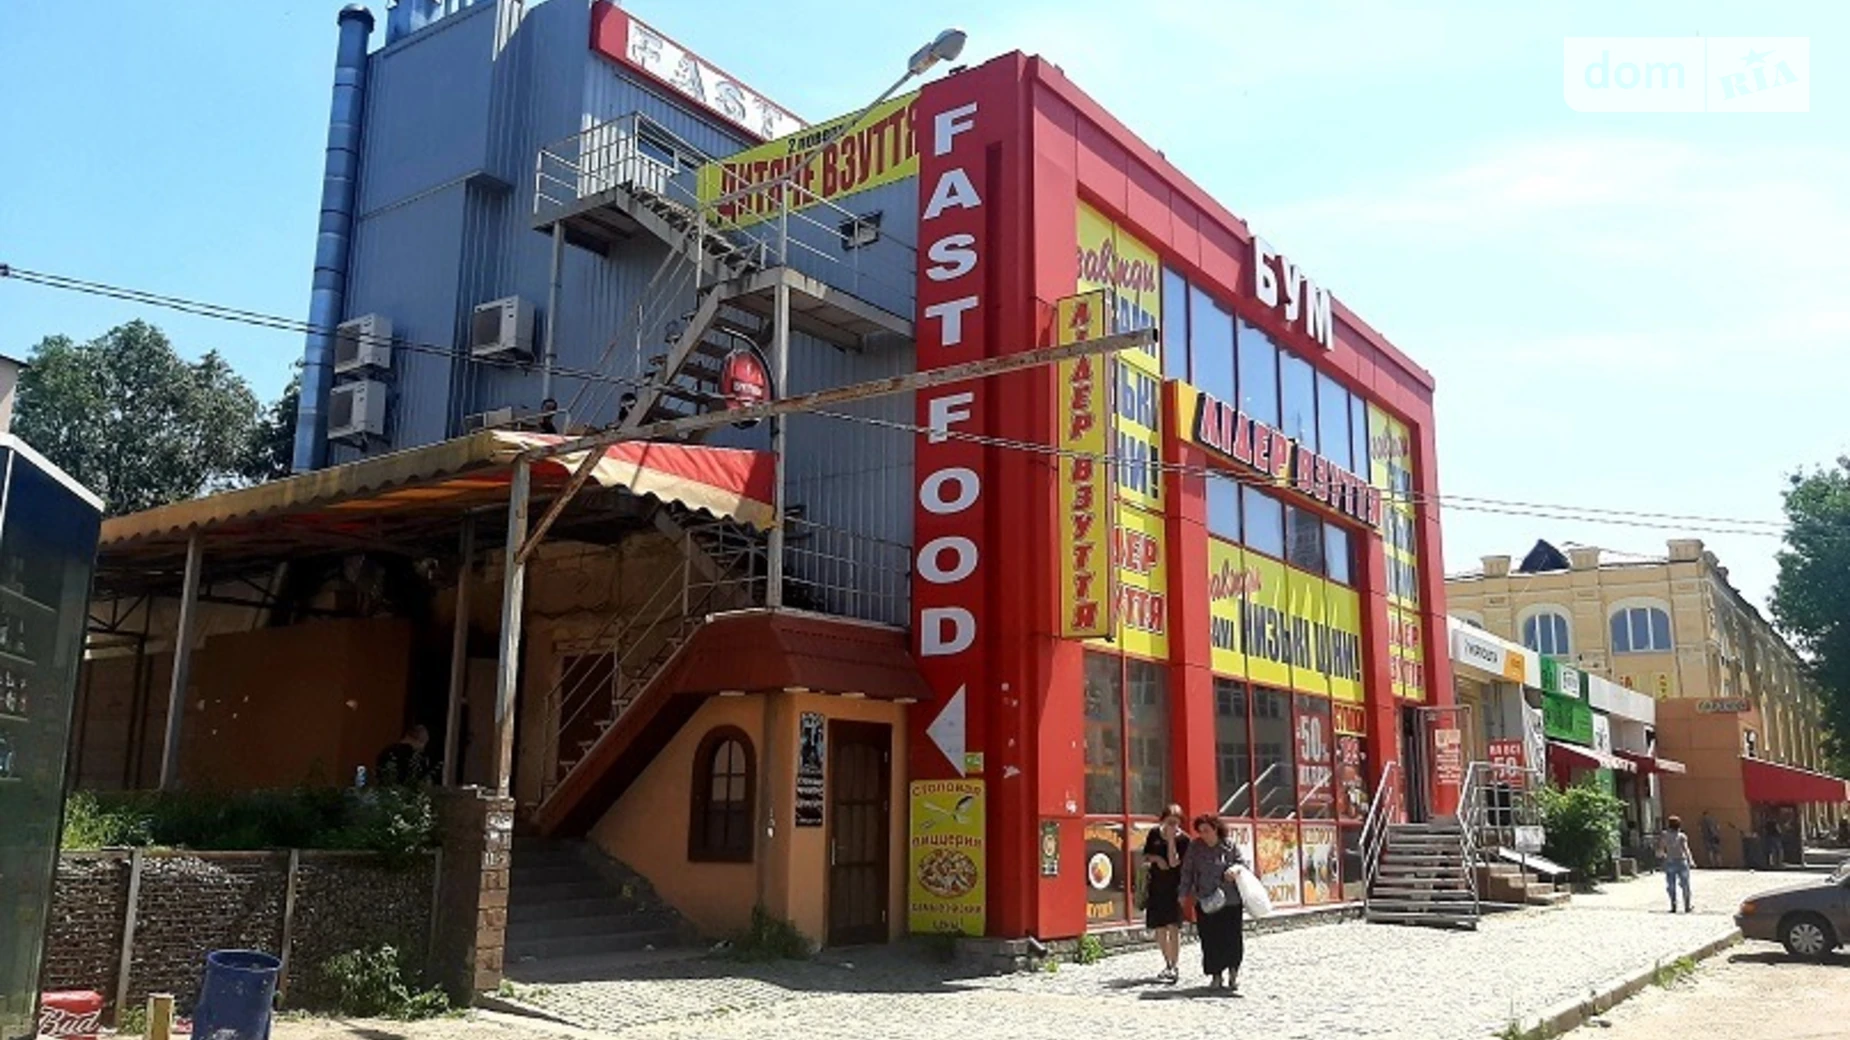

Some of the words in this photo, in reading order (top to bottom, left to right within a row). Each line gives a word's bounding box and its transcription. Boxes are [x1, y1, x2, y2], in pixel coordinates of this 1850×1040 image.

[717, 151, 815, 224] ДИТЯЧЕ
[822, 107, 918, 197] ВЗУТТЯ
[922, 101, 983, 346] FAST
[1250, 234, 1333, 351] БУМ
[916, 391, 981, 657] FOOD
[1198, 391, 1291, 482] ЛІДЕР
[1296, 440, 1381, 528] ВЗУТТЯ
[1071, 457, 1098, 630] ВЗУТТЯ
[39, 1005, 101, 1034] Bud
